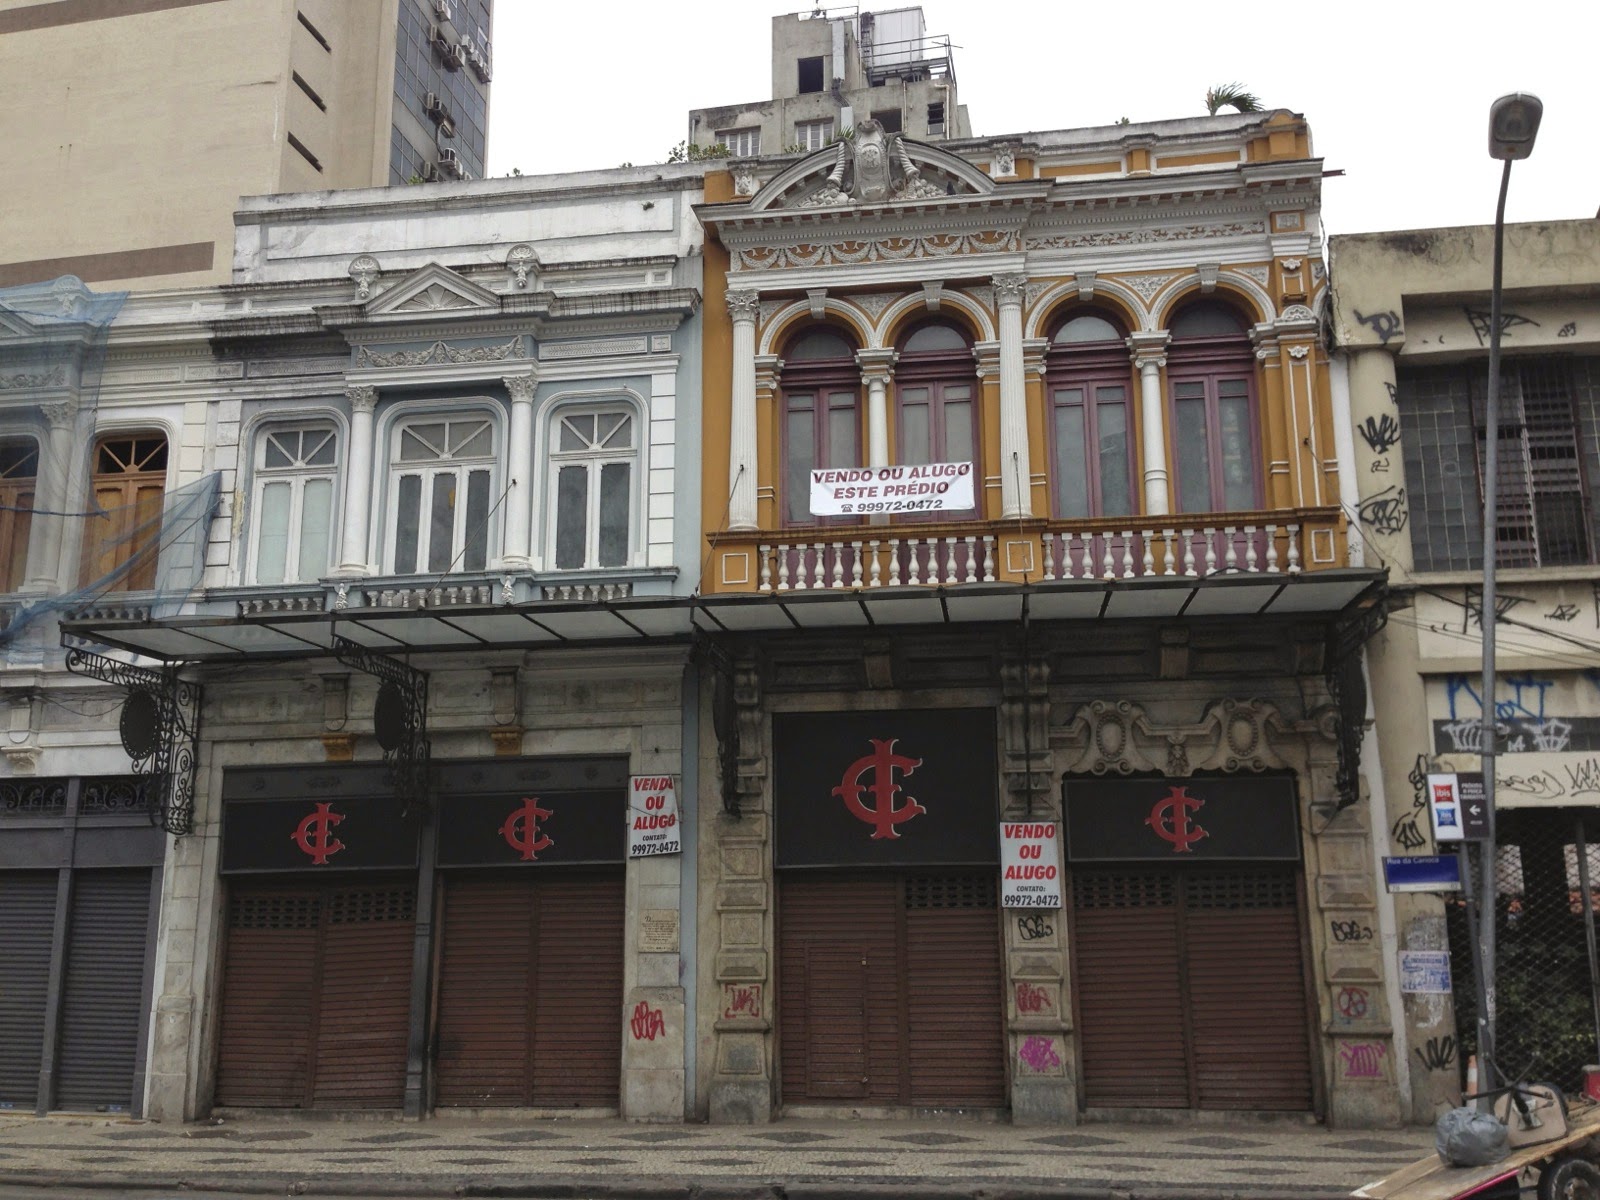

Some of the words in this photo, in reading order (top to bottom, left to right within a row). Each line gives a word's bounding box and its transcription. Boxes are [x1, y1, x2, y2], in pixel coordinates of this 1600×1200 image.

[814, 470, 873, 483] VENDO
[878, 468, 904, 481] OU
[909, 463, 970, 479] ALUGO
[833, 486, 879, 499] ESTE
[883, 481, 949, 497] PRÉDIO
[857, 499, 943, 512] 99972-0472
[645, 795, 665, 810] OU
[633, 813, 676, 830] ALUGO
[642, 834, 667, 842] CONTATO:
[1004, 824, 1055, 839] VENDO
[632, 841, 679, 855] 99972-0472
[1019, 844, 1042, 859] OU
[1386, 857, 1401, 865] Rua
[1005, 865, 1057, 880] ALUGO
[1016, 885, 1046, 893] CONTATO:
[1004, 895, 1059, 906] 99972-0472
